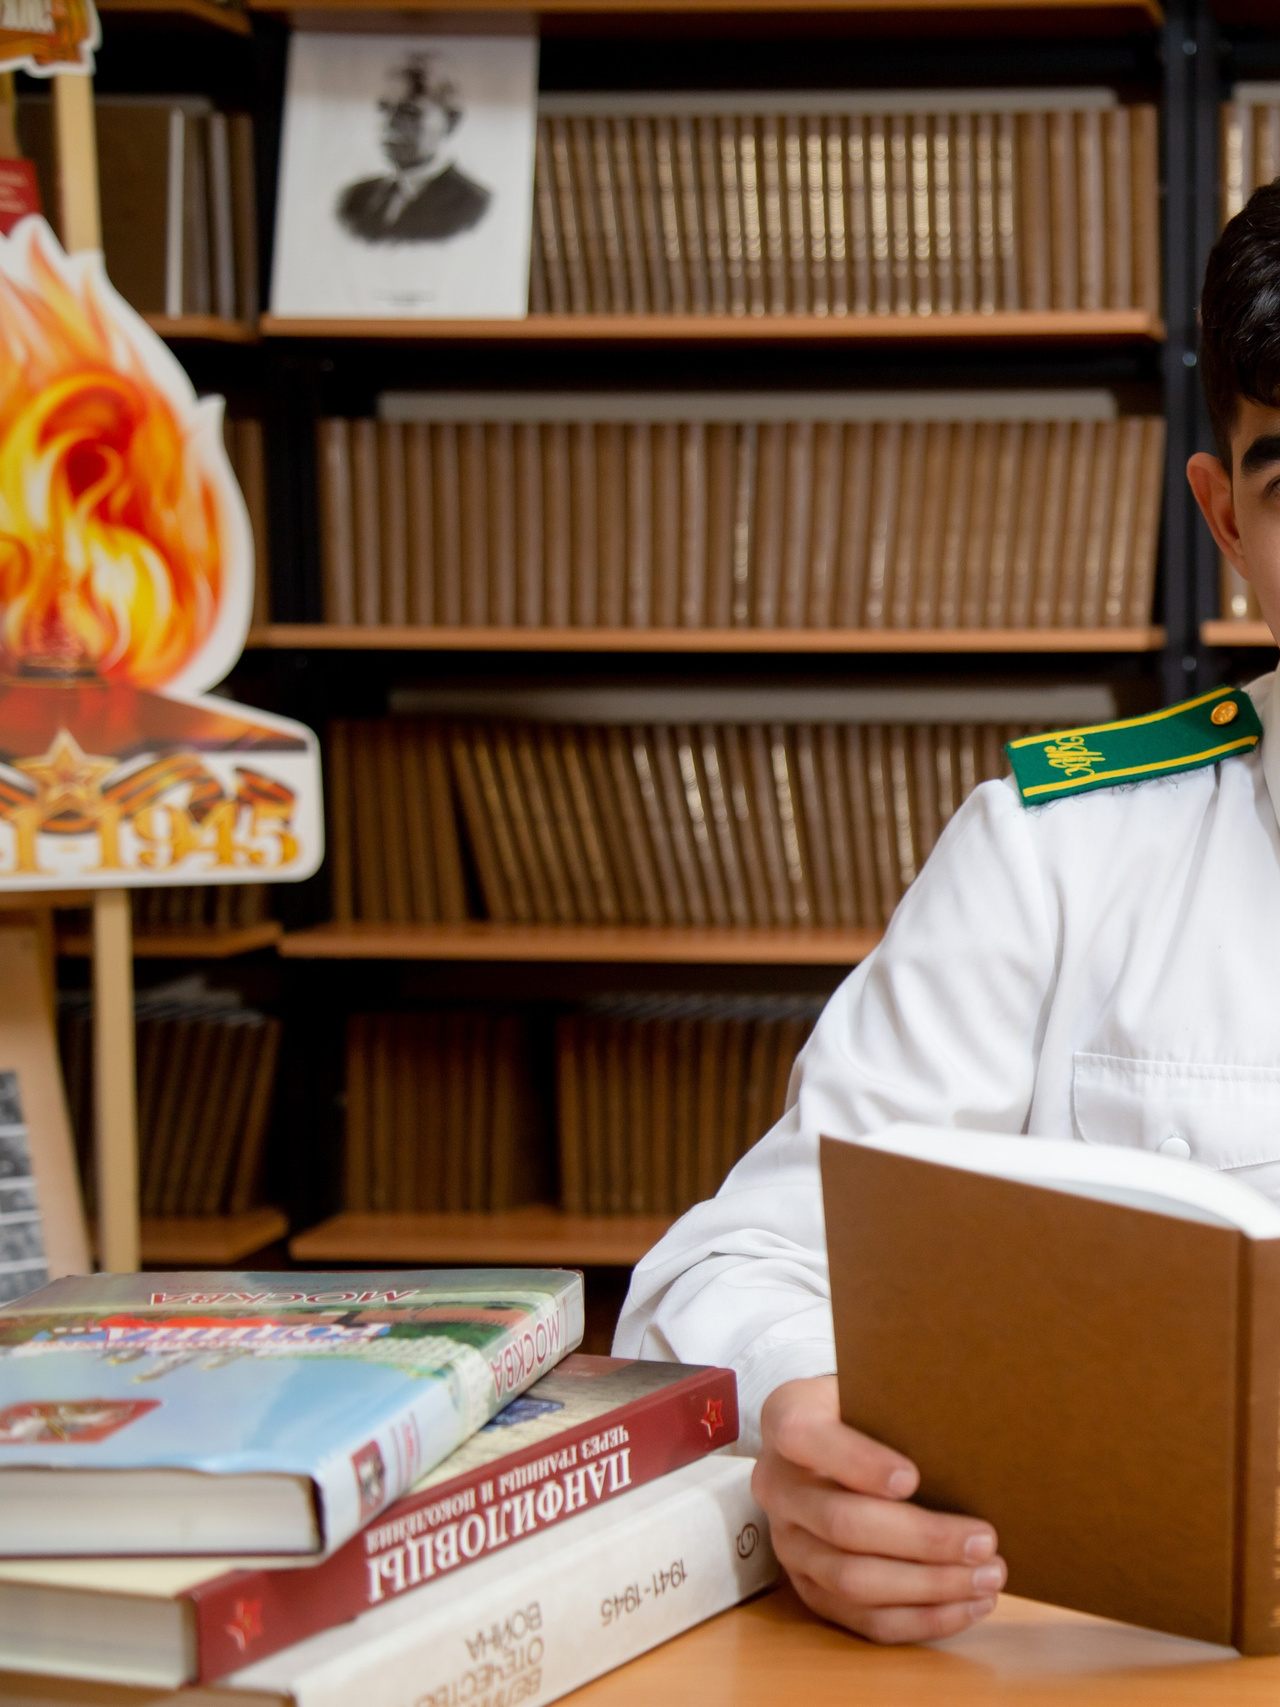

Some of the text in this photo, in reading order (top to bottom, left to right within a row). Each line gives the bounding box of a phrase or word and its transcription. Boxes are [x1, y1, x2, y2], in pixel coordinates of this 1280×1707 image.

[150, 1288, 420, 1307] МОСКВА
[489, 1308, 560, 1399] МОСКВА
[366, 1425, 630, 1555] ЧЕРЕЗ ГРАНИЦЫ И ПОКОЛЕНИЯ
[368, 1447, 632, 1604] ПАНФИЛОВЦЫ
[465, 1600, 543, 1662] ВОЙНА
[601, 1557, 688, 1628] 1941-1945
